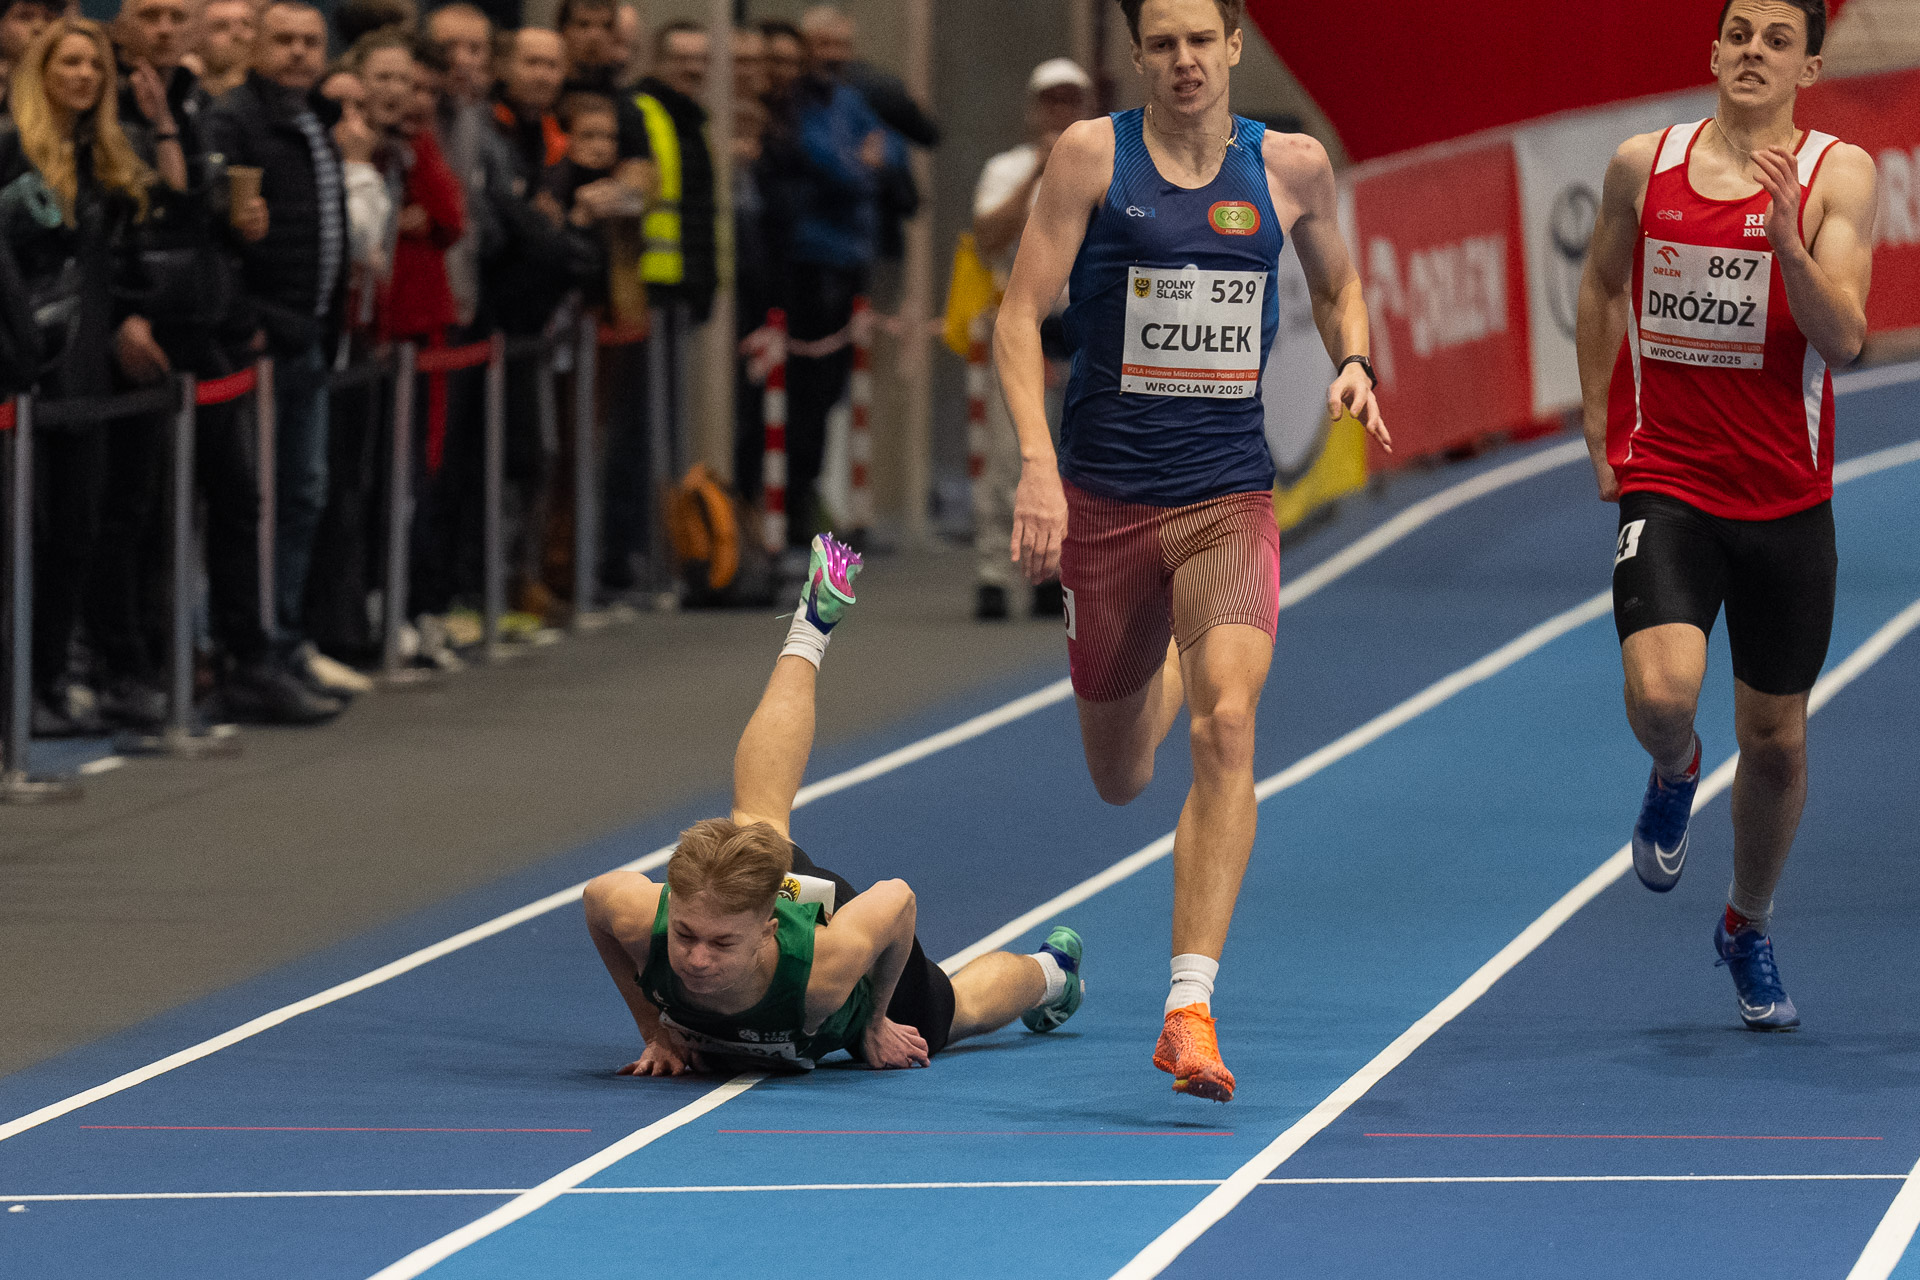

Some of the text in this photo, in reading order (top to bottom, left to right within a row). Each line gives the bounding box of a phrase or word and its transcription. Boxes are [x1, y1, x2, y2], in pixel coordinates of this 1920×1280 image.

[1126, 205, 1156, 218] esa
[1656, 209, 1683, 221] esa
[1653, 267, 1681, 278] ORLEN
[1708, 256, 1759, 281] 867
[1157, 280, 1196, 290] DOLNY
[1210, 280, 1257, 304] 529
[1156, 288, 1193, 300] ŚLĄSK
[1649, 290, 1757, 327] DRÓŻDŻ
[1141, 323, 1252, 353] CZUŁEK
[1650, 346, 1742, 365] WROCŁAW 2025
[1127, 366, 1144, 375] PZLA
[1145, 369, 1172, 377] Halowe
[1173, 371, 1216, 379] Mistrzostwa
[1145, 381, 1244, 395] WROCŁAW 2025
[1614, 525, 1632, 558] 4
